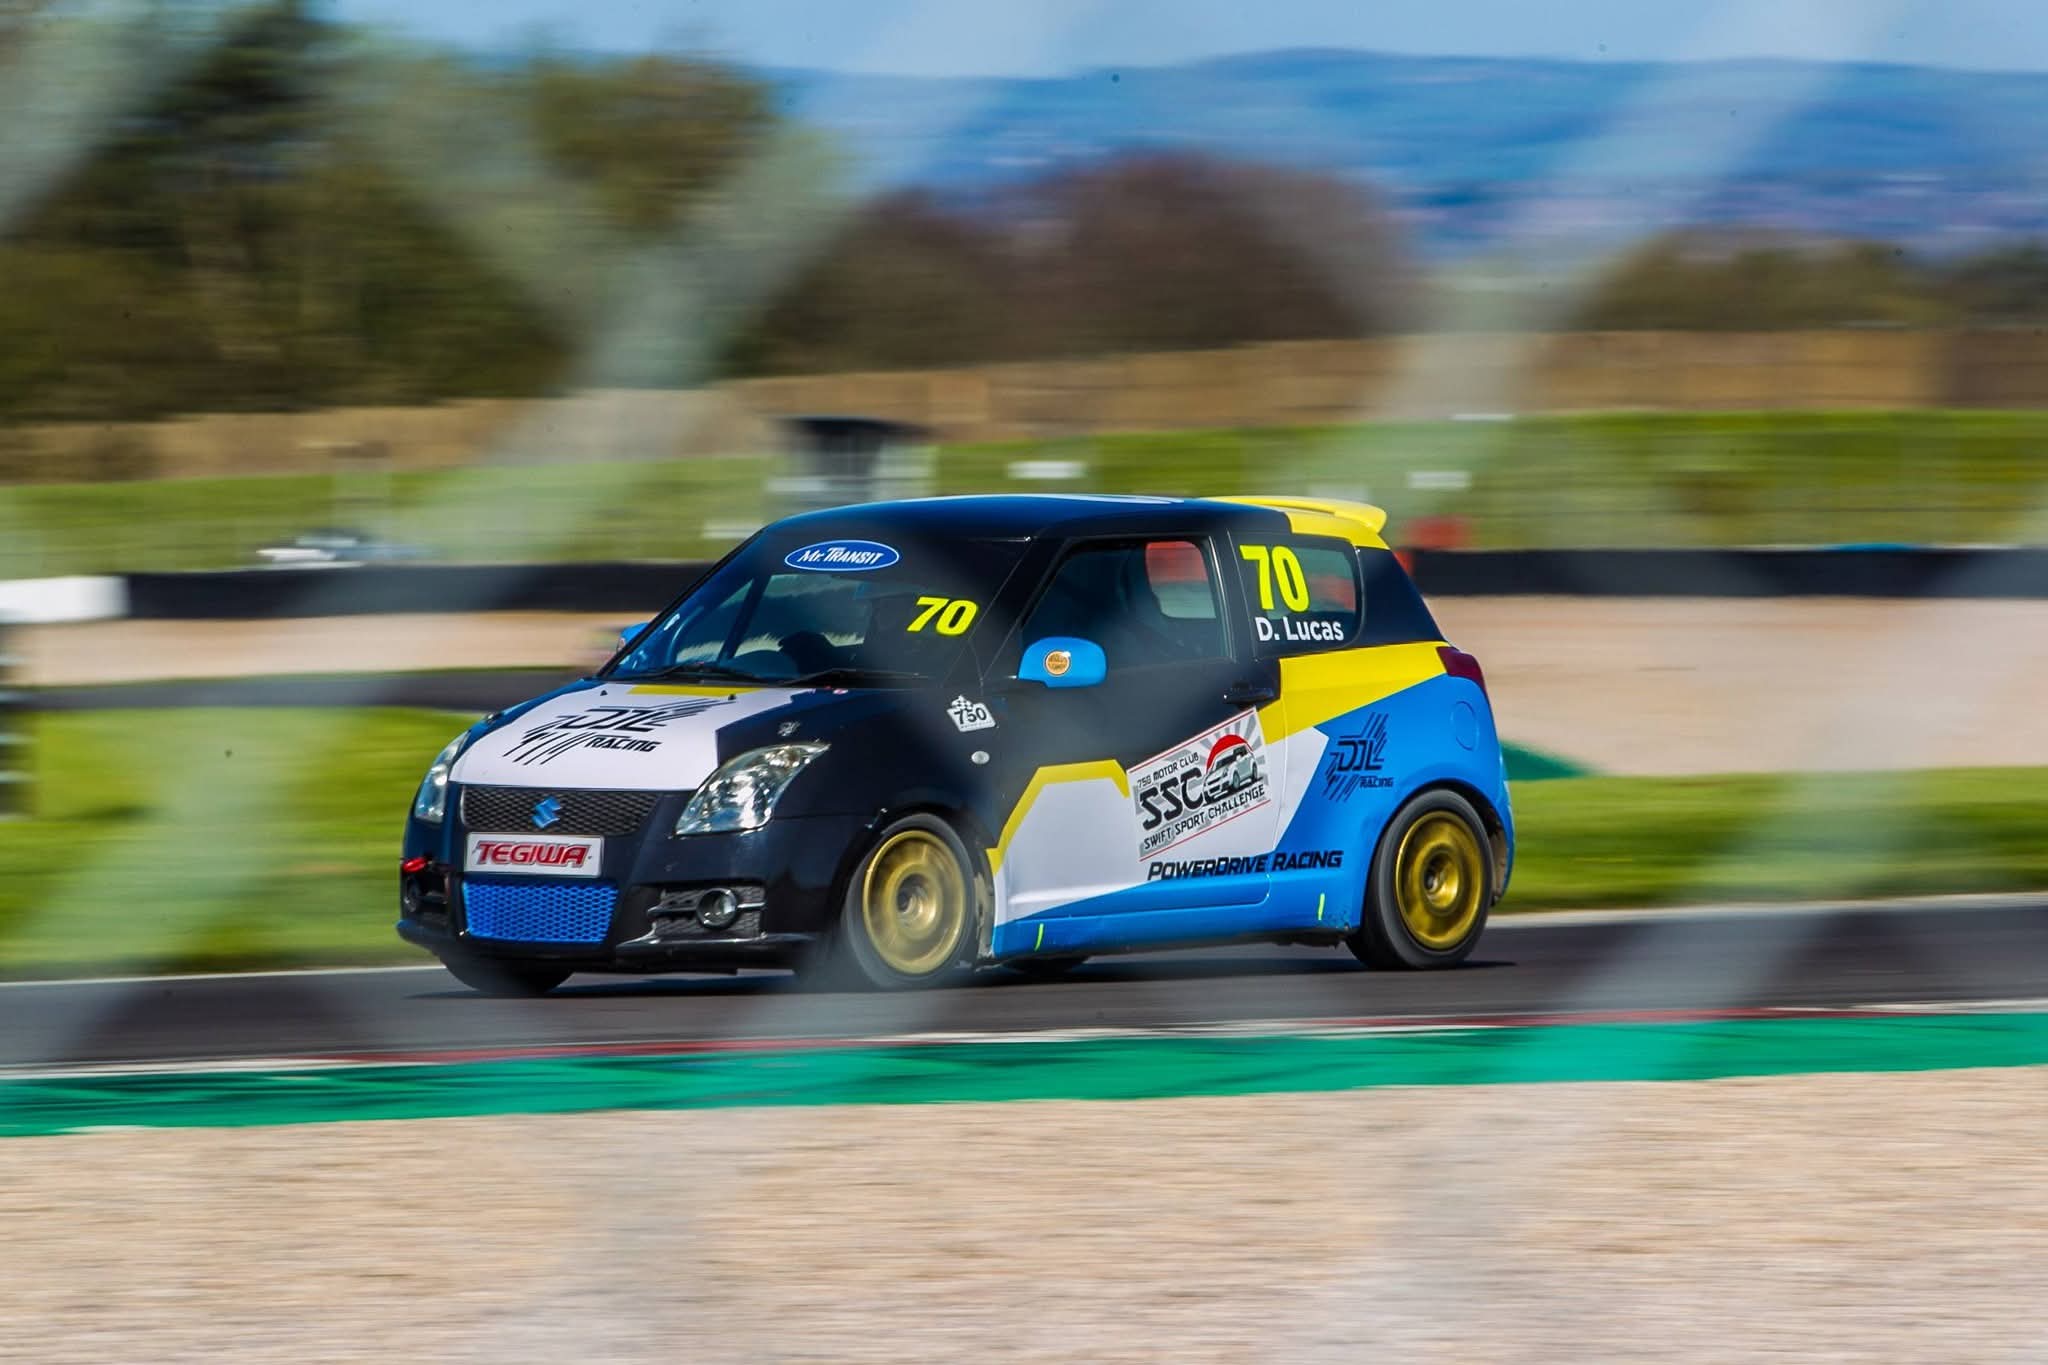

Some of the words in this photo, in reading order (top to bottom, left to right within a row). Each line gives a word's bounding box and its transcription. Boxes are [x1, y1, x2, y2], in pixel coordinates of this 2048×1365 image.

[1240, 545, 1309, 612] 70
[907, 596, 978, 635] 70
[1255, 616, 1280, 641] D.
[1283, 616, 1344, 641] Lucas
[954, 707, 987, 724] 750
[585, 736, 662, 753] RACING
[1153, 762, 1179, 781] MOTOR
[1180, 751, 1199, 769] CLUB
[1139, 766, 1203, 831] SSC
[1144, 827, 1172, 850] SWIFT
[1175, 811, 1206, 836] SPORT
[1208, 784, 1266, 820] CHALLENGE
[475, 841, 591, 868] TEGIWA
[1272, 850, 1343, 871] RACING
